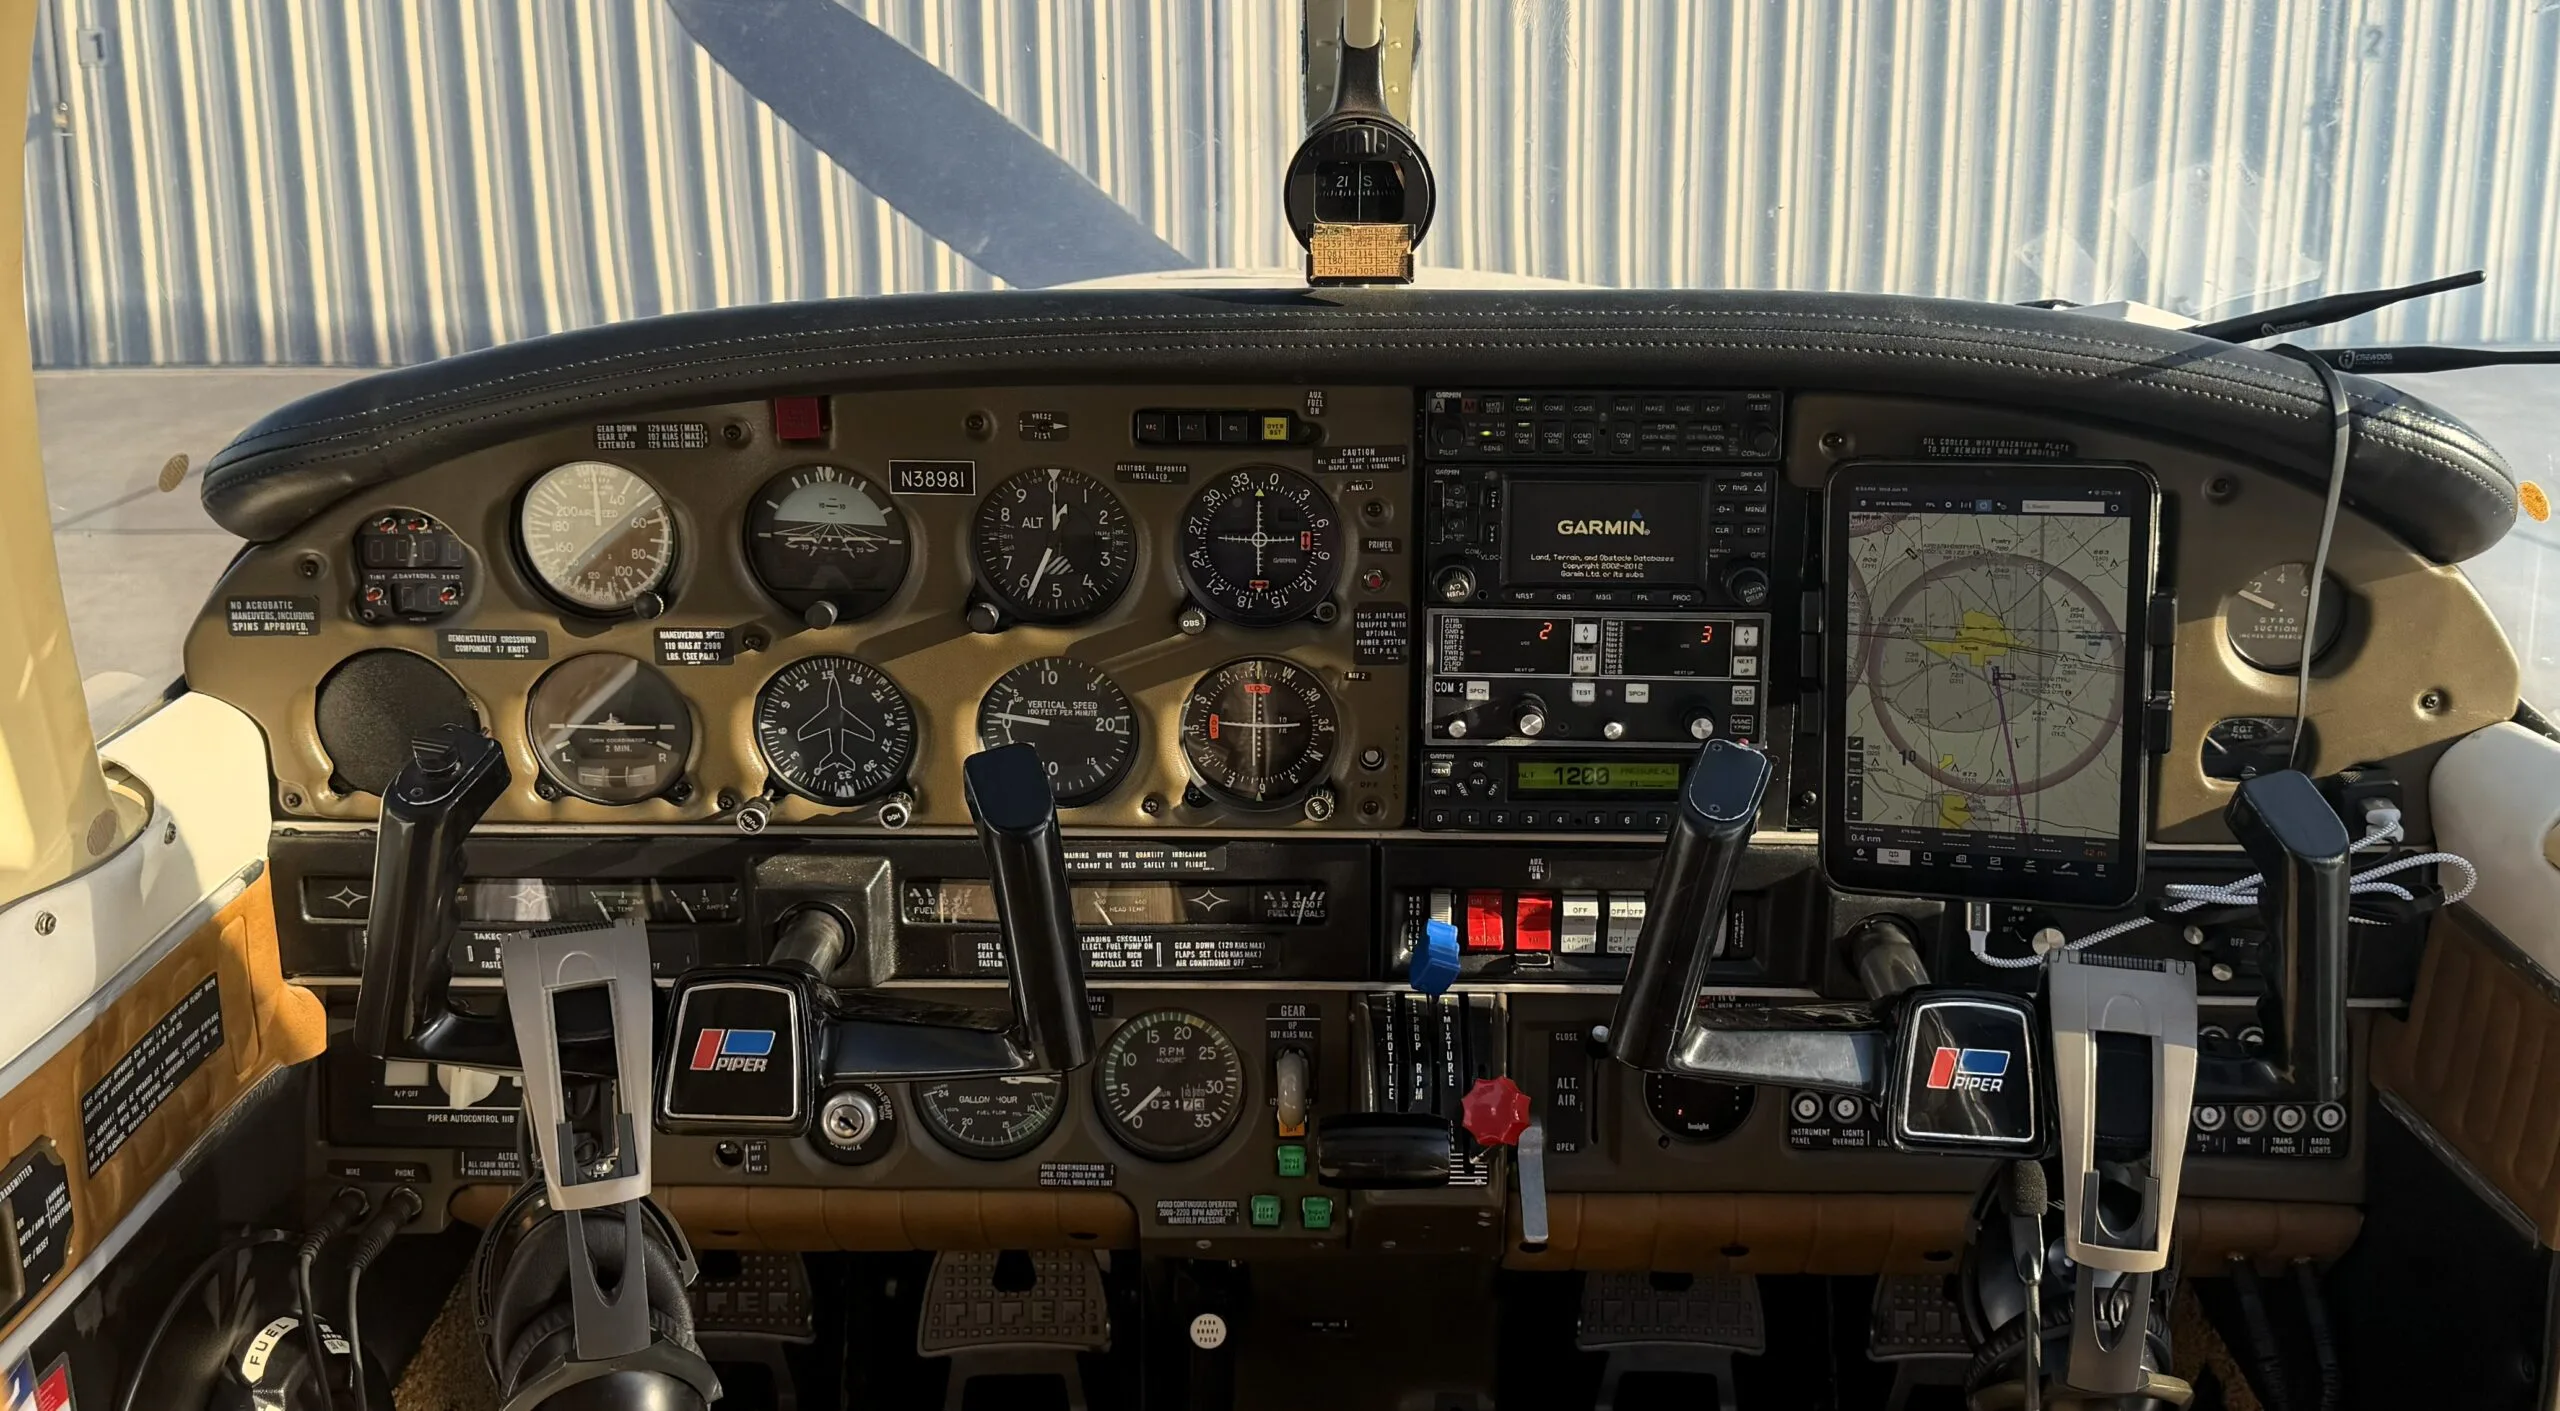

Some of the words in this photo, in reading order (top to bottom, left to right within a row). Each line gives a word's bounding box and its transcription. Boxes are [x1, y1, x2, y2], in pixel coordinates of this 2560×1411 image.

[93, 34, 104, 60] 1
[1336, 176, 1348, 188] 21
[1363, 175, 1373, 187] S
[661, 424, 678, 432] KIAS
[1342, 448, 1375, 456] CAUTION
[1116, 464, 1146, 472] ALTITUDE
[901, 470, 965, 488] N38981
[1132, 472, 1168, 480] INSTALLED
[1230, 472, 1250, 488] 33
[1732, 484, 1748, 492] RNG
[609, 495, 625, 506] 40
[1016, 488, 1026, 504] 9
[1202, 489, 1221, 507] 30
[556, 506, 578, 517] 200
[1001, 508, 1010, 522] 8
[1100, 510, 1108, 524] 2
[631, 518, 648, 528] 60
[1022, 516, 1044, 529] ALT
[1188, 516, 1203, 535] 27
[1368, 540, 1392, 549] PRIMER
[632, 548, 646, 560] 80
[1100, 552, 1111, 567] 3
[1189, 550, 1206, 568] 24
[1530, 554, 1550, 562] Land,
[1554, 554, 1582, 562] Terrain,
[1600, 554, 1632, 562] Obstacle
[1634, 554, 1674, 562] Databases
[1003, 556, 1012, 570] 7
[1562, 562, 1600, 570] Copyright
[614, 566, 632, 577] 100
[1019, 574, 1030, 588] 6
[1082, 574, 1094, 588] 4
[1206, 579, 1225, 596] 21
[1300, 577, 1318, 592] 12
[1052, 584, 1062, 598] 5
[2254, 582, 2263, 594] 2
[2300, 586, 2310, 597] 6
[230, 600, 242, 610] NO
[246, 600, 294, 610] ACROBATIC
[1237, 595, 1253, 609] 18
[1270, 595, 1288, 609] 15
[232, 622, 259, 631] SPINS
[1538, 622, 1553, 640] 2
[448, 634, 497, 643] DEMONSTRATED
[500, 636, 537, 644] CROSSWIND
[706, 631, 725, 640] SPEED
[1700, 626, 1713, 644] 3
[454, 644, 492, 653] COMPONENT
[507, 646, 530, 654] KNOTS
[848, 674, 863, 686] 18
[1040, 670, 1059, 685] 10
[794, 679, 810, 692] 12
[1434, 682, 1455, 693] COM
[1458, 682, 1464, 693] 2
[871, 690, 886, 703] 21
[1027, 700, 1066, 710] VERTICAL
[1072, 701, 1098, 710] SPEED
[1306, 688, 1321, 702] 30
[1318, 718, 1330, 732] 33
[884, 712, 895, 728] 24
[1095, 718, 1116, 732] 20
[562, 752, 572, 762] L
[658, 752, 667, 763] R
[1086, 757, 1096, 766] 15
[1554, 766, 1610, 786] 1200
[1497, 814, 1504, 822] 2
[1556, 816, 1563, 824] 4
[1594, 816, 1600, 824] 5
[1851, 834, 1865, 842] 0.4
[1866, 836, 1881, 844] nm
[1532, 872, 1540, 880] ON
[914, 906, 936, 914] FUEL
[977, 942, 994, 950] FUEL
[1174, 942, 1192, 950] GEAR
[1196, 942, 1215, 950] DOWN
[1091, 960, 1126, 968] PROPELLER
[1280, 1004, 1306, 1018] GEAR
[1146, 1030, 1160, 1044] 15
[1174, 1026, 1192, 1040] 20
[1413, 1016, 1422, 1051] PROP
[1555, 1032, 1578, 1041] CLOSE
[1159, 1047, 1184, 1056] RPM
[1198, 1046, 1217, 1060] 25
[1443, 1016, 1454, 1086] MIXTURE
[1122, 1052, 1138, 1066] 10
[1386, 1016, 1394, 1100] THROTTLE
[715, 1058, 768, 1072] PIPER
[1205, 1080, 1224, 1094] 30
[1415, 1062, 1423, 1100] RPM
[1556, 1077, 1578, 1090] ALT.
[1952, 1076, 2004, 1092] PIPER
[408, 1090, 418, 1098] OFF
[1120, 1083, 1130, 1097] 5
[958, 1096, 990, 1104] GALLON
[1558, 1094, 1576, 1106] AIR
[427, 1114, 448, 1122] PIPER
[450, 1114, 499, 1123] AUTOCONTROL
[961, 1117, 974, 1126] 20
[1132, 1115, 1143, 1129] 0
[1194, 1114, 1212, 1128] 35
[1688, 1122, 1710, 1132] Insight
[1790, 1128, 1830, 1136] INSTRUMENT
[1842, 1129, 1864, 1137] LIGHTS
[1556, 1143, 1575, 1151] OPEN
[1791, 1136, 1810, 1145] PANEL
[1832, 1138, 1864, 1146] OVERHEAD
[2270, 1146, 2296, 1154] PONDER
[2309, 1146, 2332, 1154] LIGHTS
[468, 1160, 478, 1168] ALL
[346, 1168, 360, 1176] MIKE
[394, 1168, 415, 1176] PHONE
[468, 1168, 488, 1176] HEATER
[49, 1194, 66, 1216] FLIGHT
[51, 1200, 72, 1228] POSITION
[1206, 1208, 1224, 1216] ABOVE
[249, 1322, 290, 1366] FUEL
